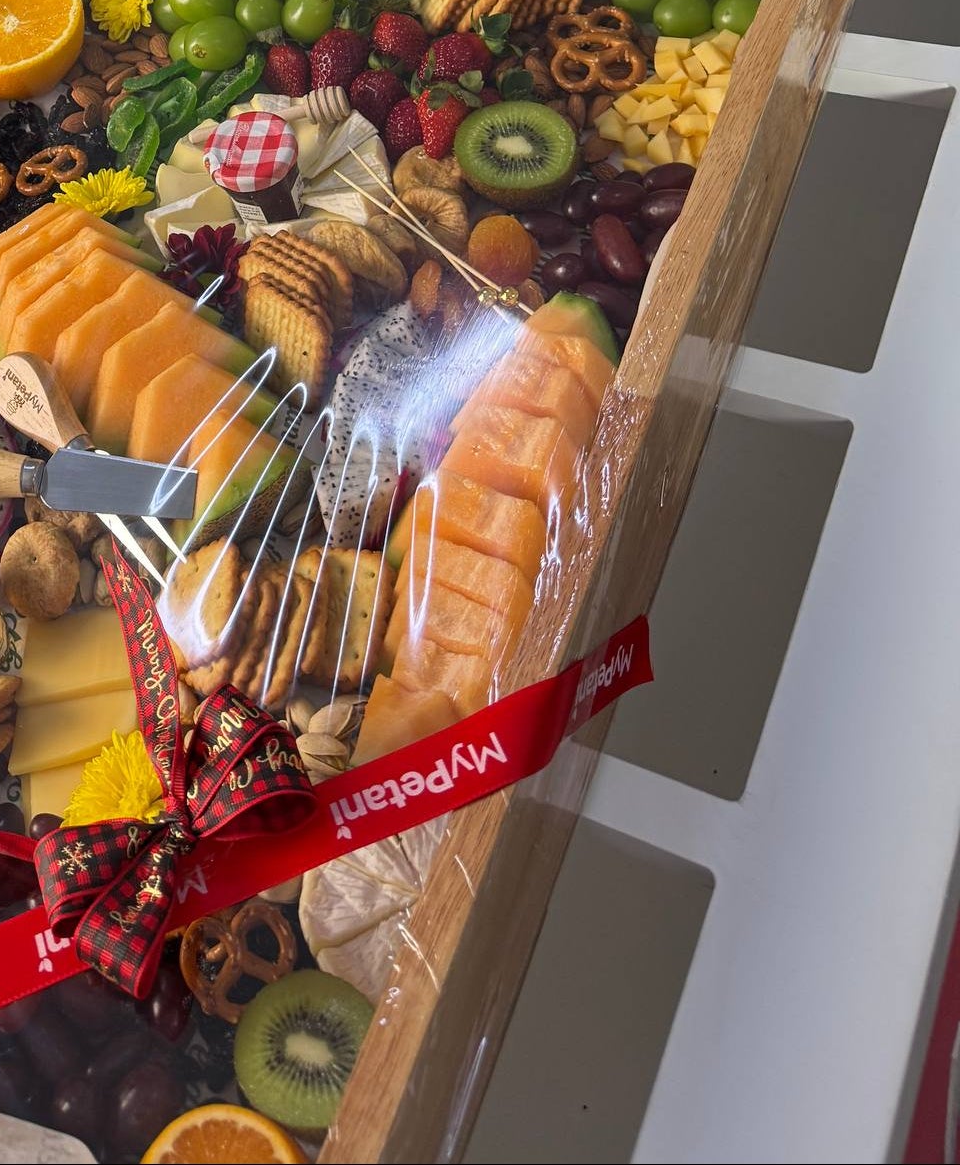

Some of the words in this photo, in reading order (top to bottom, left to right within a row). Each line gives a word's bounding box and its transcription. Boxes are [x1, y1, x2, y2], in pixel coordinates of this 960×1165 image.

[2, 367, 44, 415] MyPetani
[136, 608, 168, 696] Merry
[329, 730, 509, 841] MyPetani
